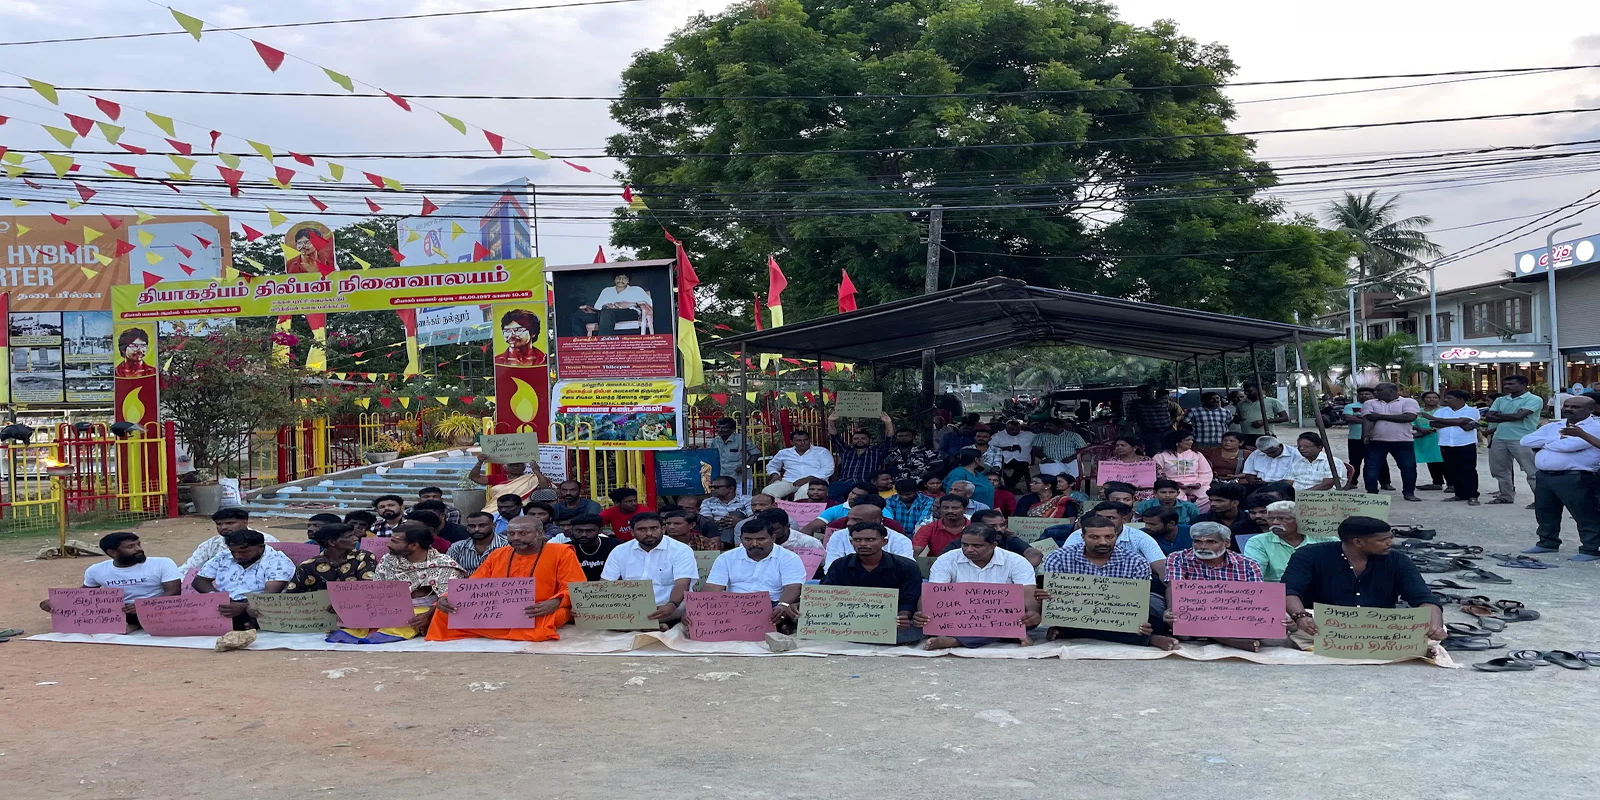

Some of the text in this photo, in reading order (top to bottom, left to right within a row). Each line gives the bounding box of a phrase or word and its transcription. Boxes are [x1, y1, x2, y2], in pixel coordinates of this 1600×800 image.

[8, 244, 100, 265] HYBRID
[138, 265, 509, 305] தியாகதீபம் திலீபன் நினைவாலயம்
[17, 290, 102, 299] தடையில்லா
[1441, 347, 1478, 360] Rio
[106, 577, 147, 586] HUSTLE
[456, 582, 499, 592] SHAME
[965, 588, 1010, 597] MEMORY
[686, 594, 718, 603] POLICE
[1178, 597, 1207, 605] அனுர
[456, 601, 478, 609] STOP
[697, 600, 763, 610] MUST STOP
[936, 600, 962, 609] OUR
[473, 612, 504, 620] HATE
[741, 608, 764, 616] BOW
[933, 611, 950, 619] WE
[1324, 607, 1359, 618] அனுர
[712, 618, 733, 627] THE
[1322, 638, 1364, 651] தியாகி
